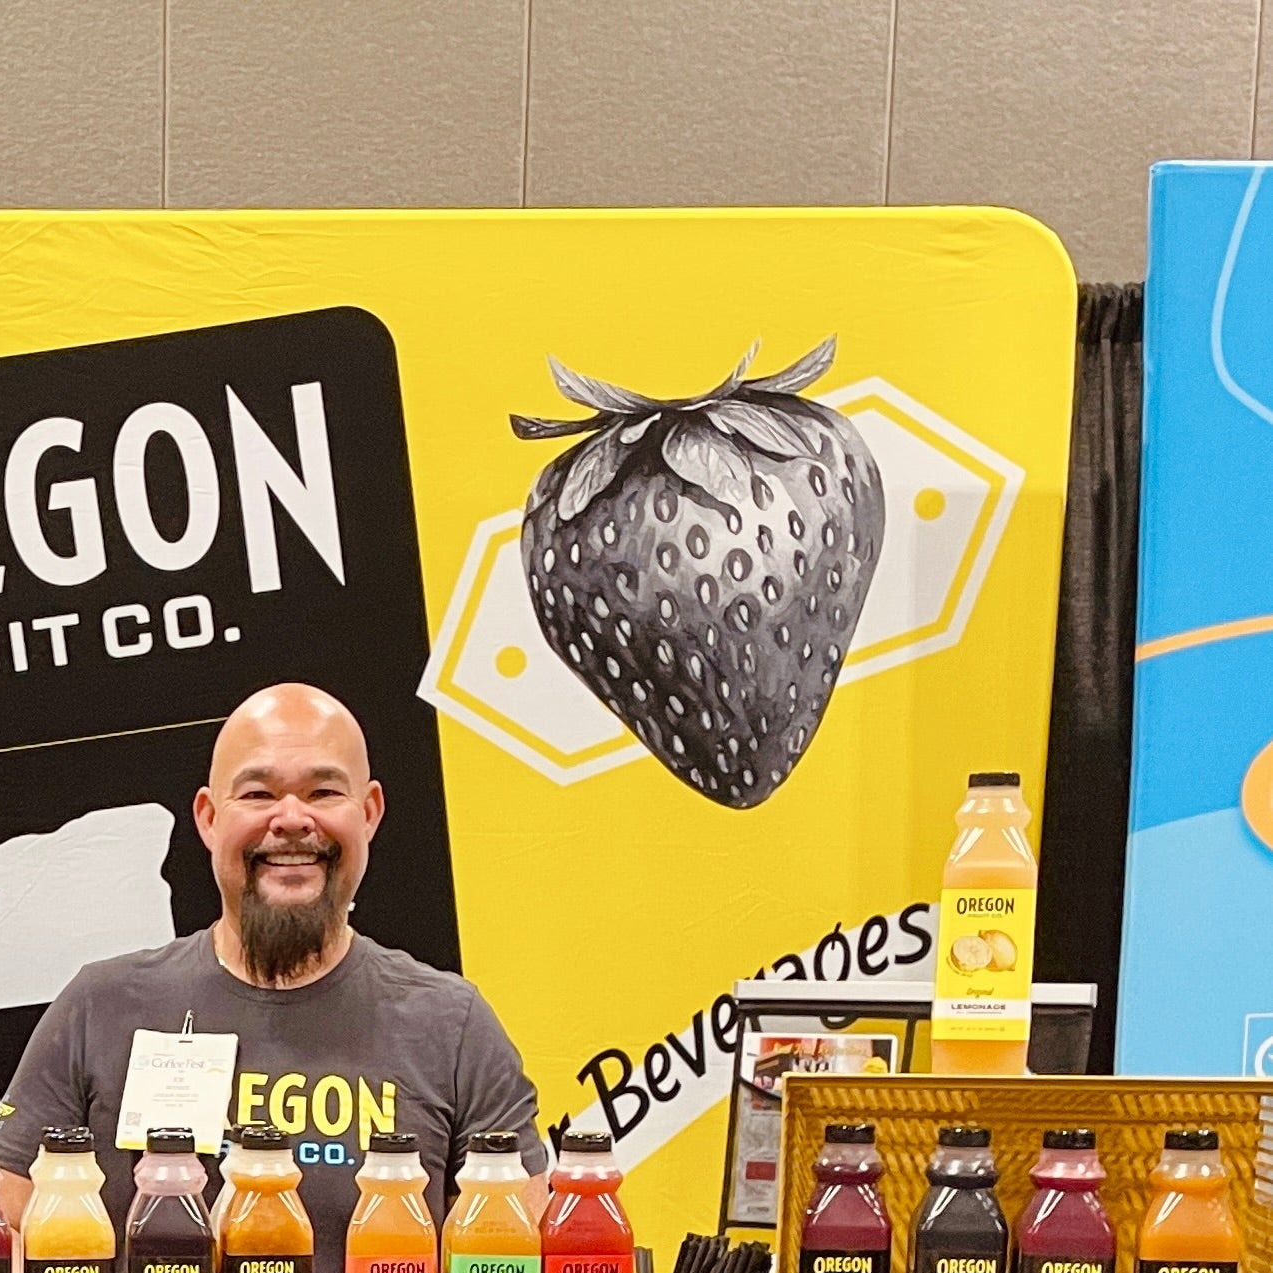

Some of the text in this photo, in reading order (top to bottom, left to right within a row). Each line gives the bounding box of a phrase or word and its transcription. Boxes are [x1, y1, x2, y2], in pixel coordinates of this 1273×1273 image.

[101, 594, 242, 659] CO.
[956, 897, 1015, 915] OREGON
[951, 1003, 1007, 1011] LEMONADE
[237, 1072, 396, 1151] EGON
[298, 1141, 356, 1166] CO.
